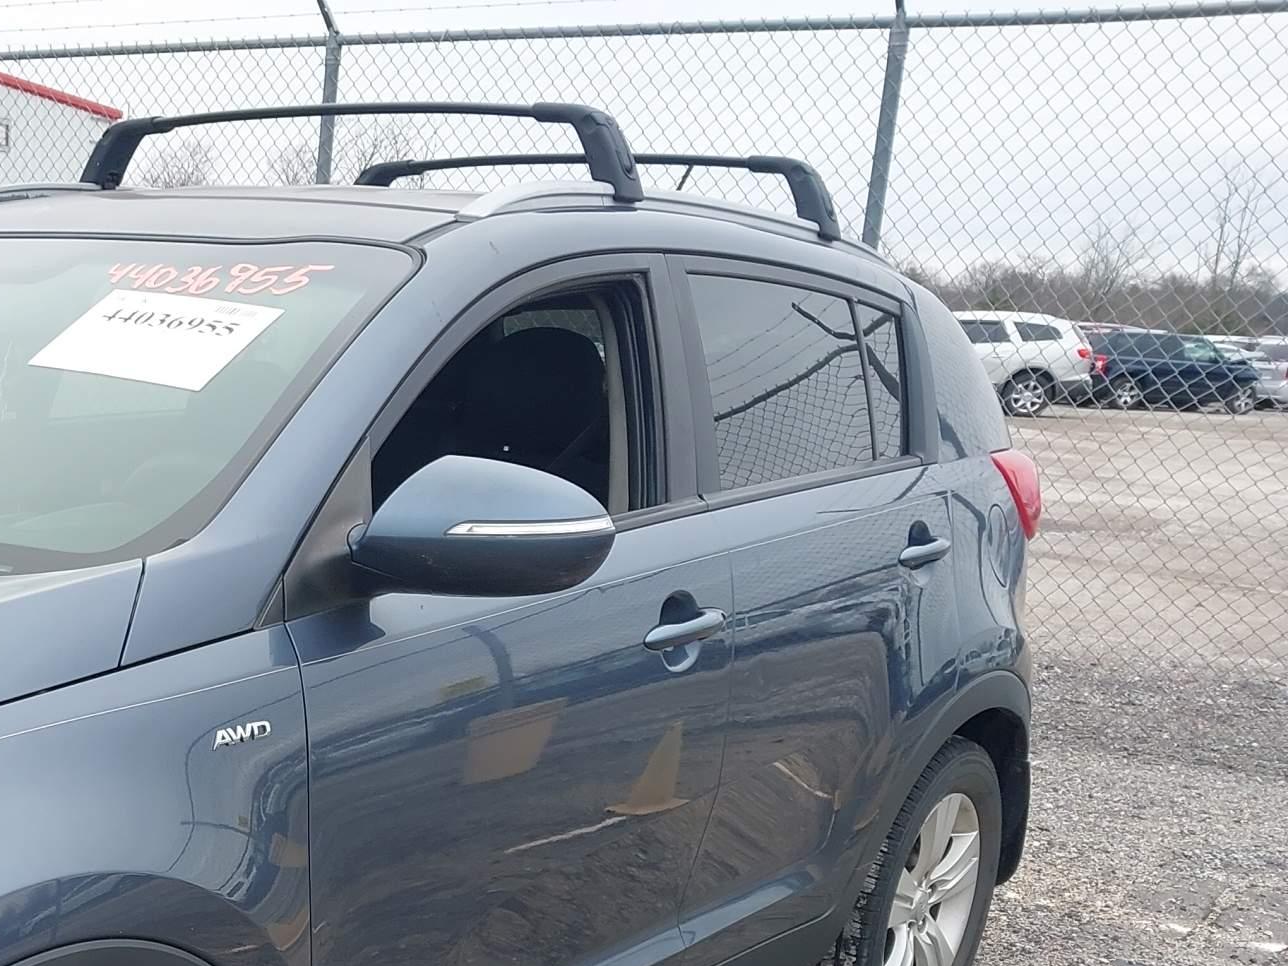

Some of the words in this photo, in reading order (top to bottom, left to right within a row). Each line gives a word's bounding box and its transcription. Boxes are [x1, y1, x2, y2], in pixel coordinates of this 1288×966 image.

[106, 262, 335, 295] 44036955
[102, 308, 241, 337] 44036955
[212, 720, 272, 751] AWD
